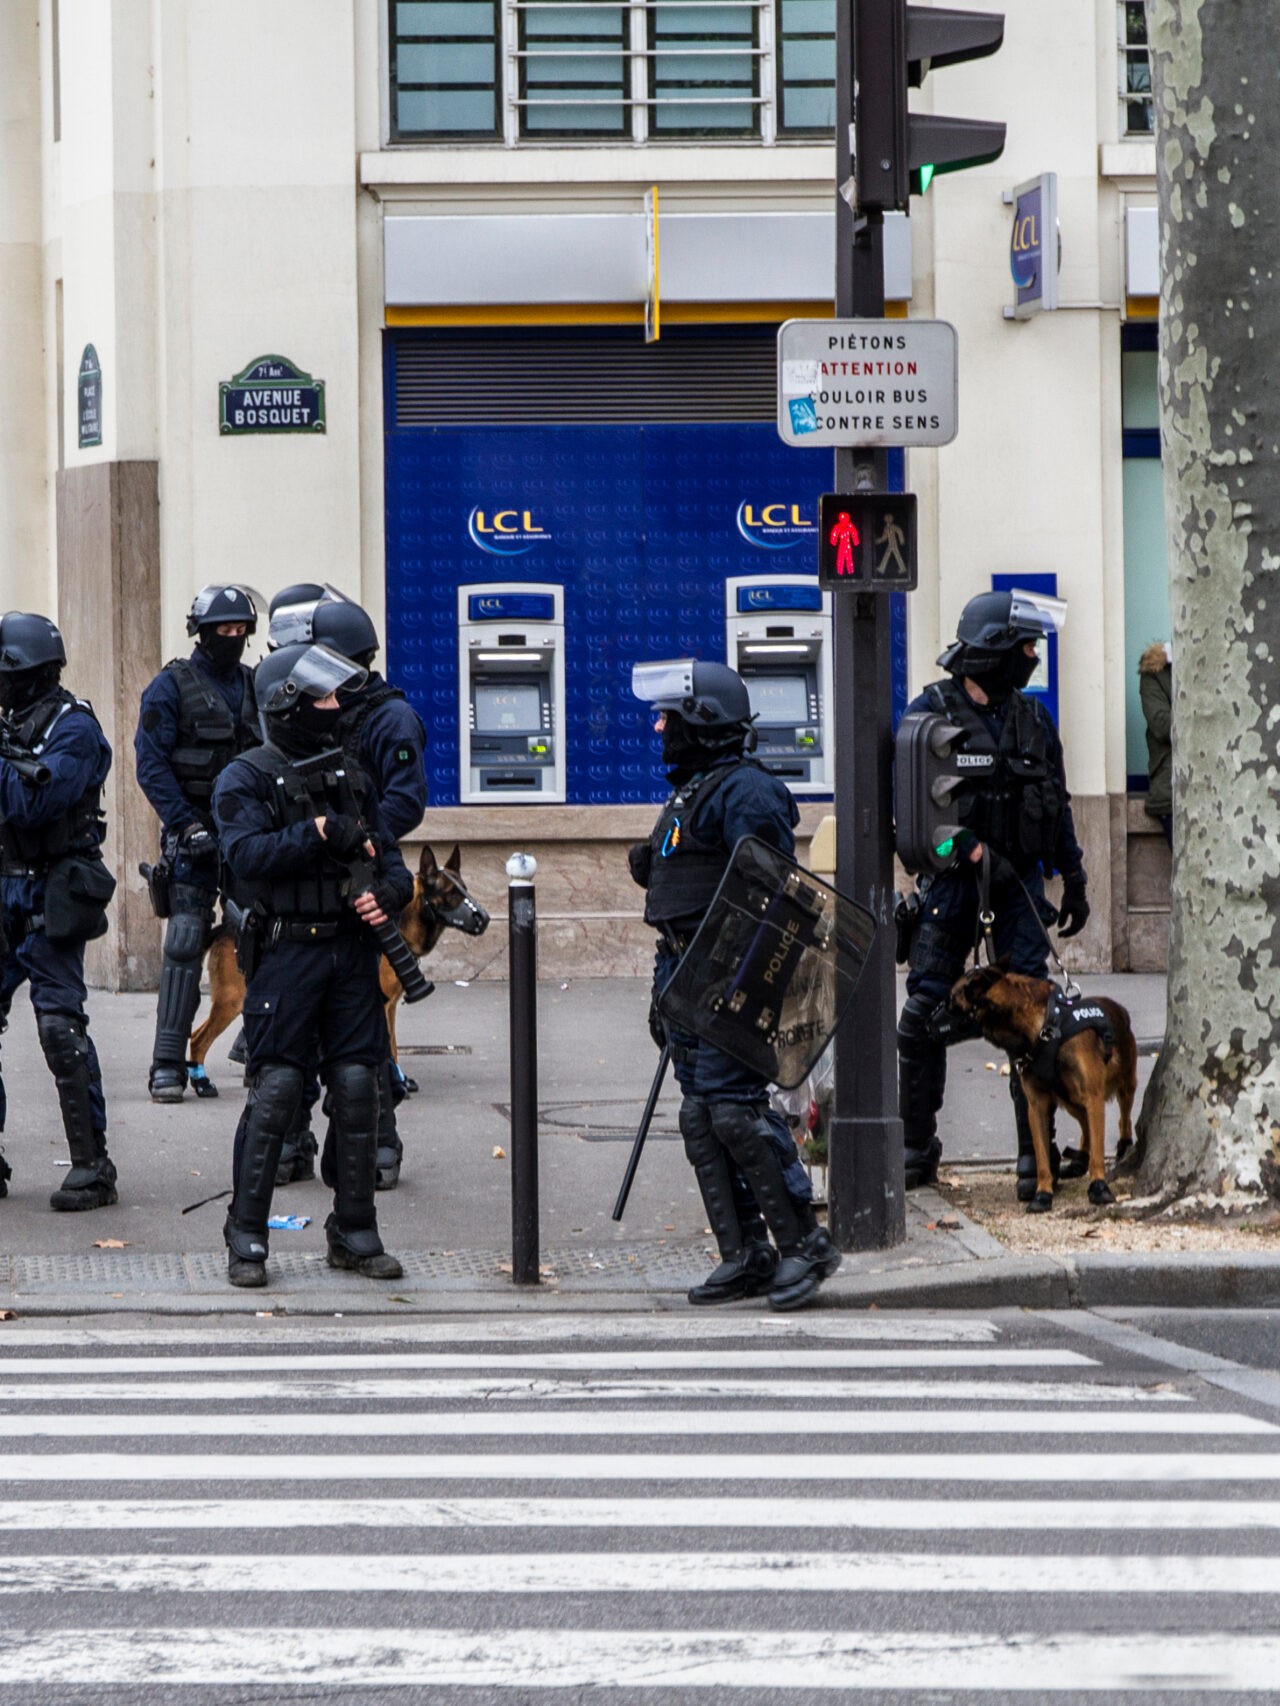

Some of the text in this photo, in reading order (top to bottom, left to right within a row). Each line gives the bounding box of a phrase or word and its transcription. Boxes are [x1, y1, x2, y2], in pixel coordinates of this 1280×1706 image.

[1013, 215, 1039, 252] LCL
[829, 333, 906, 350] PIÉTONS
[821, 362, 918, 376] ATTENTION
[243, 390, 302, 407] AVENUE
[893, 390, 928, 403] BUS
[235, 408, 310, 425] BOSQUET
[816, 416, 940, 430] CONTRE SENS
[476, 510, 545, 533] LCL
[745, 504, 812, 526] LCL
[957, 754, 993, 766] OLICE
[764, 919, 801, 985] POLICE
